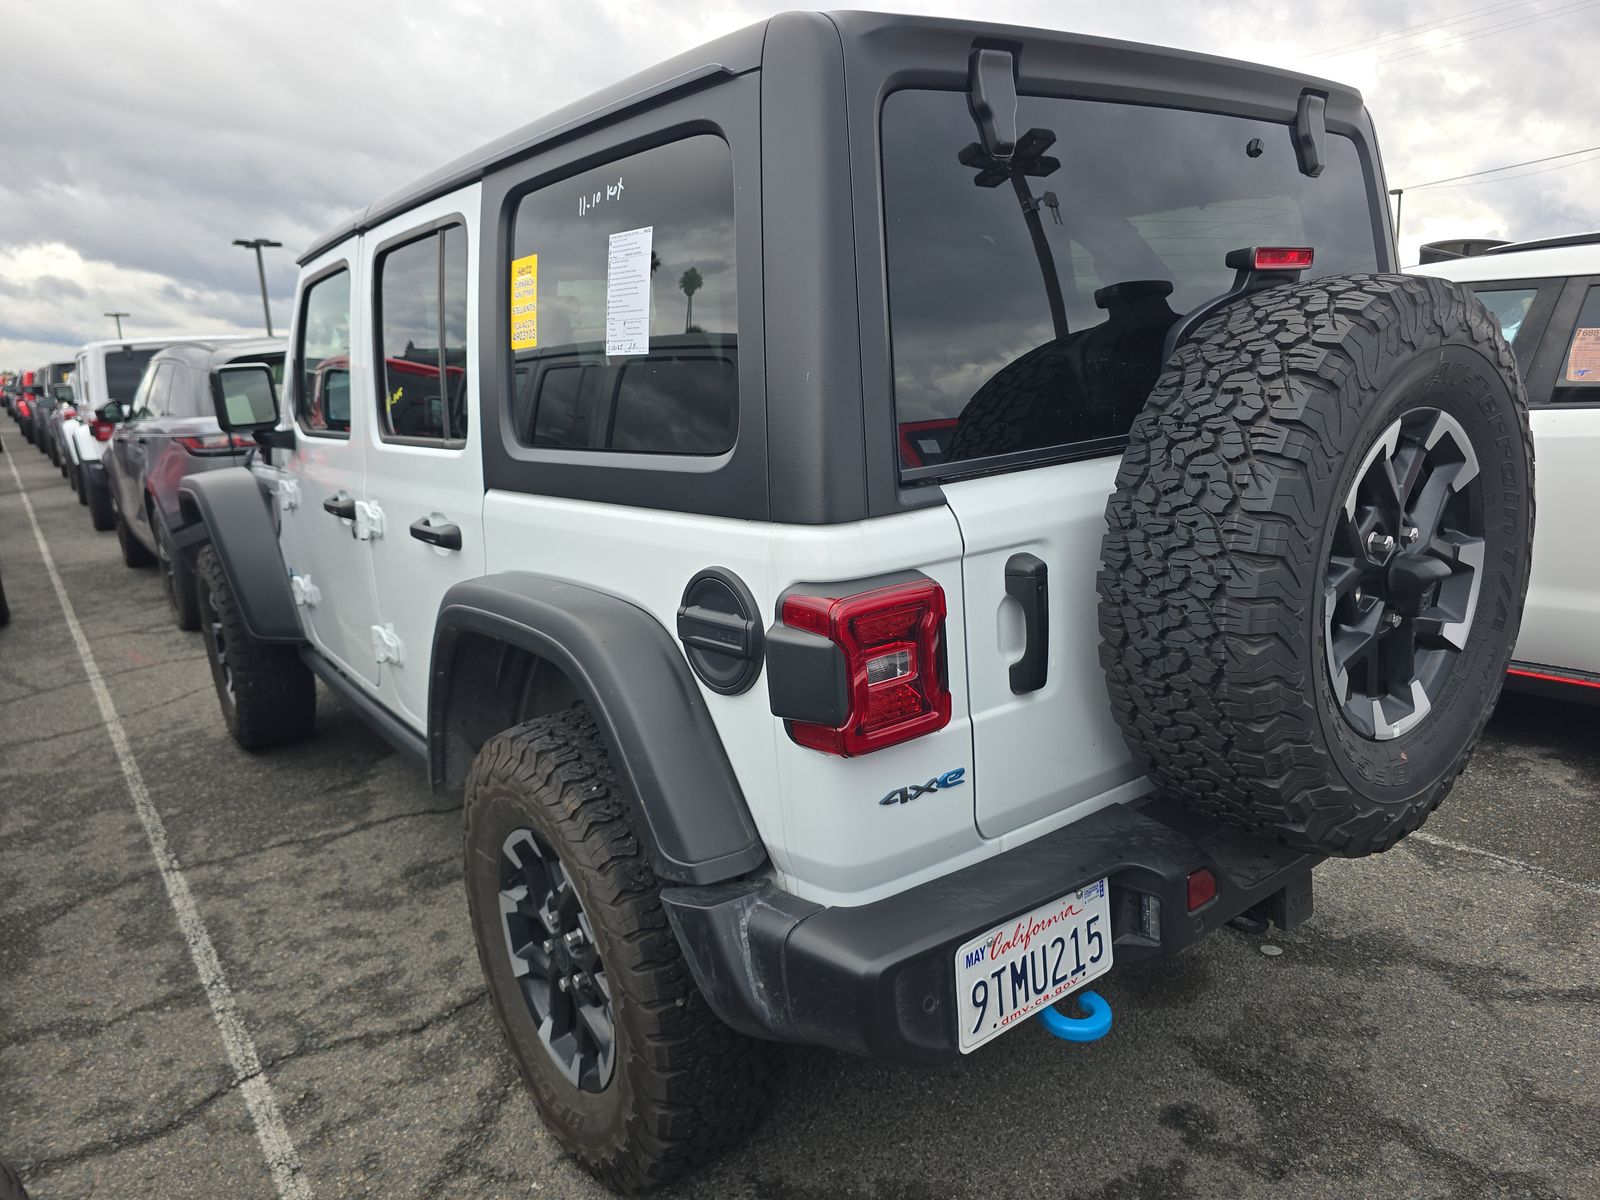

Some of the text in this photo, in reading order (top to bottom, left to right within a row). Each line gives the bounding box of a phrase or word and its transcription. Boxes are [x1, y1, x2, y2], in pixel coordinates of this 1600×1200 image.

[965, 902, 1083, 969] MAY California
[972, 914, 1104, 1034] 9TMU215
[1001, 976, 1078, 1026] dmv.ca.gov
